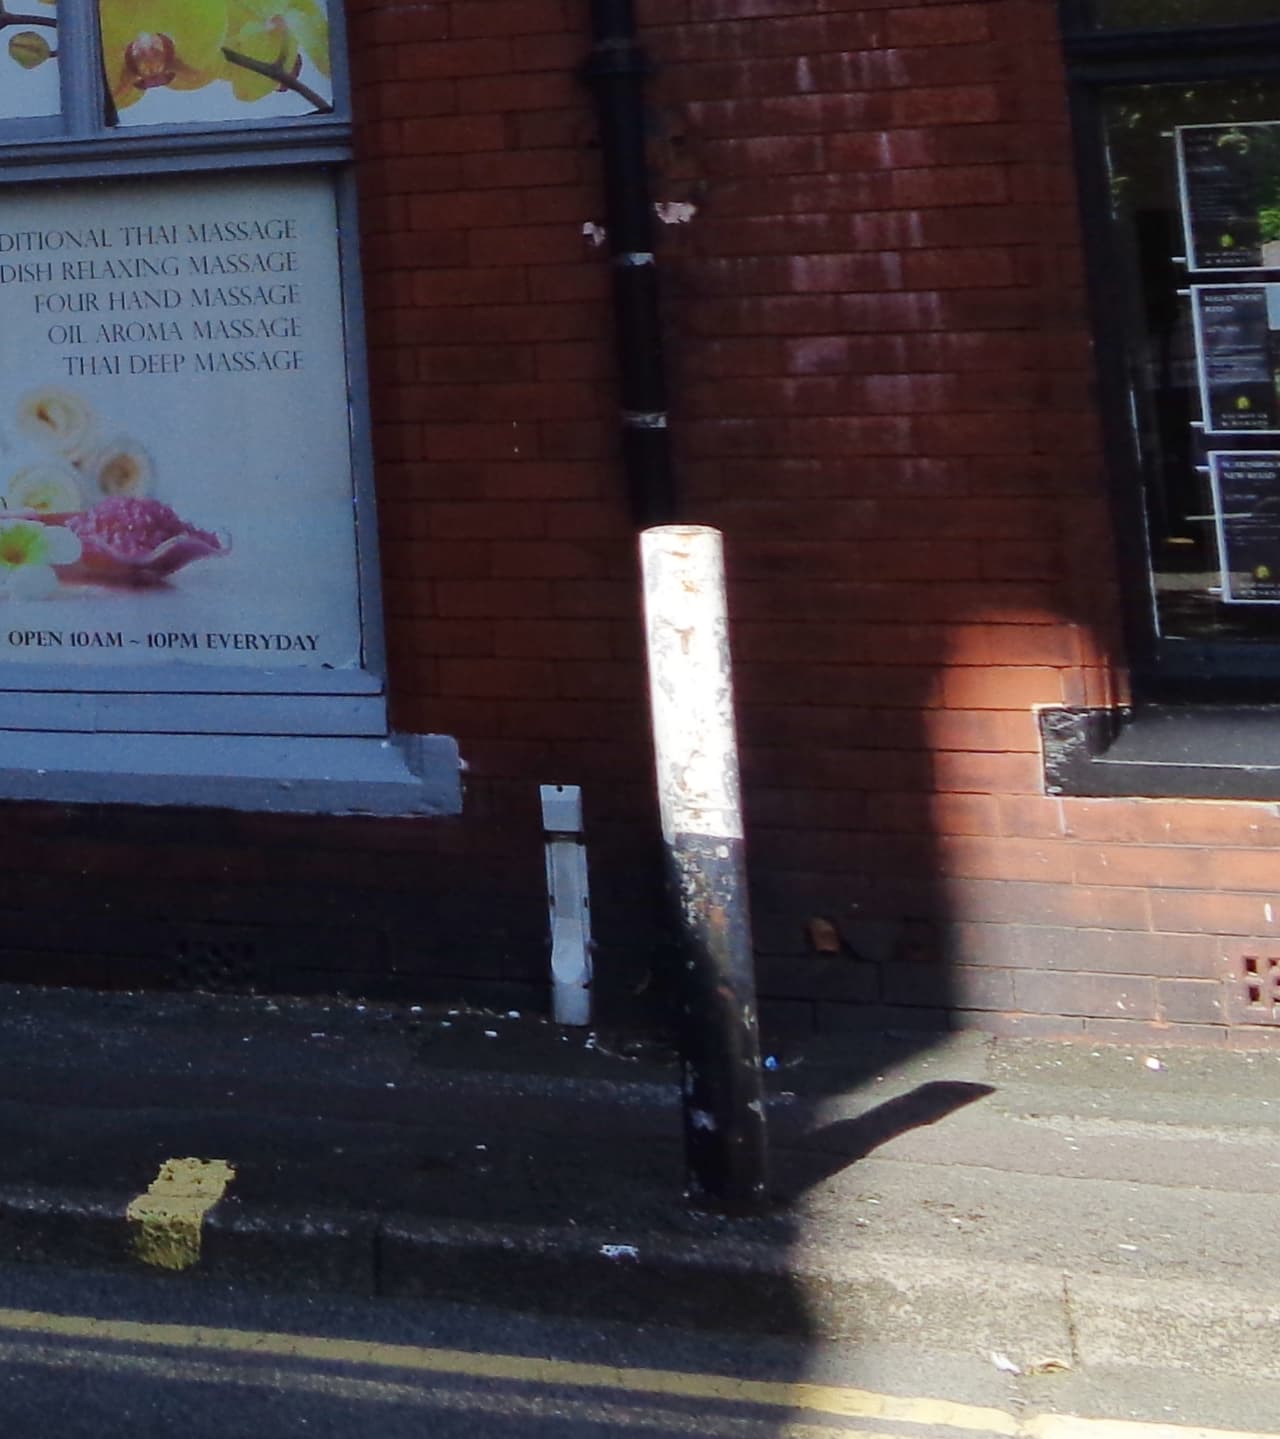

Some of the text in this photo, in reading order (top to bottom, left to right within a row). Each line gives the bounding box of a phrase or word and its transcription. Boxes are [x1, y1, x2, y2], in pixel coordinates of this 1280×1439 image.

[120, 225, 177, 246] THAI
[188, 219, 297, 243] MASSAGE
[62, 257, 179, 280] RELAXING
[189, 251, 298, 275] MASSAGE
[34, 284, 301, 313] FOUR HAND MASSAGE
[48, 317, 302, 345] OIL AROMA MASSAGE
[62, 350, 305, 376] THAI DEEP MASSAGE
[8, 630, 63, 647] OPEN
[69, 631, 123, 648] 10AM
[147, 633, 198, 649] 10PM
[206, 633, 319, 652] EVERYDAY
